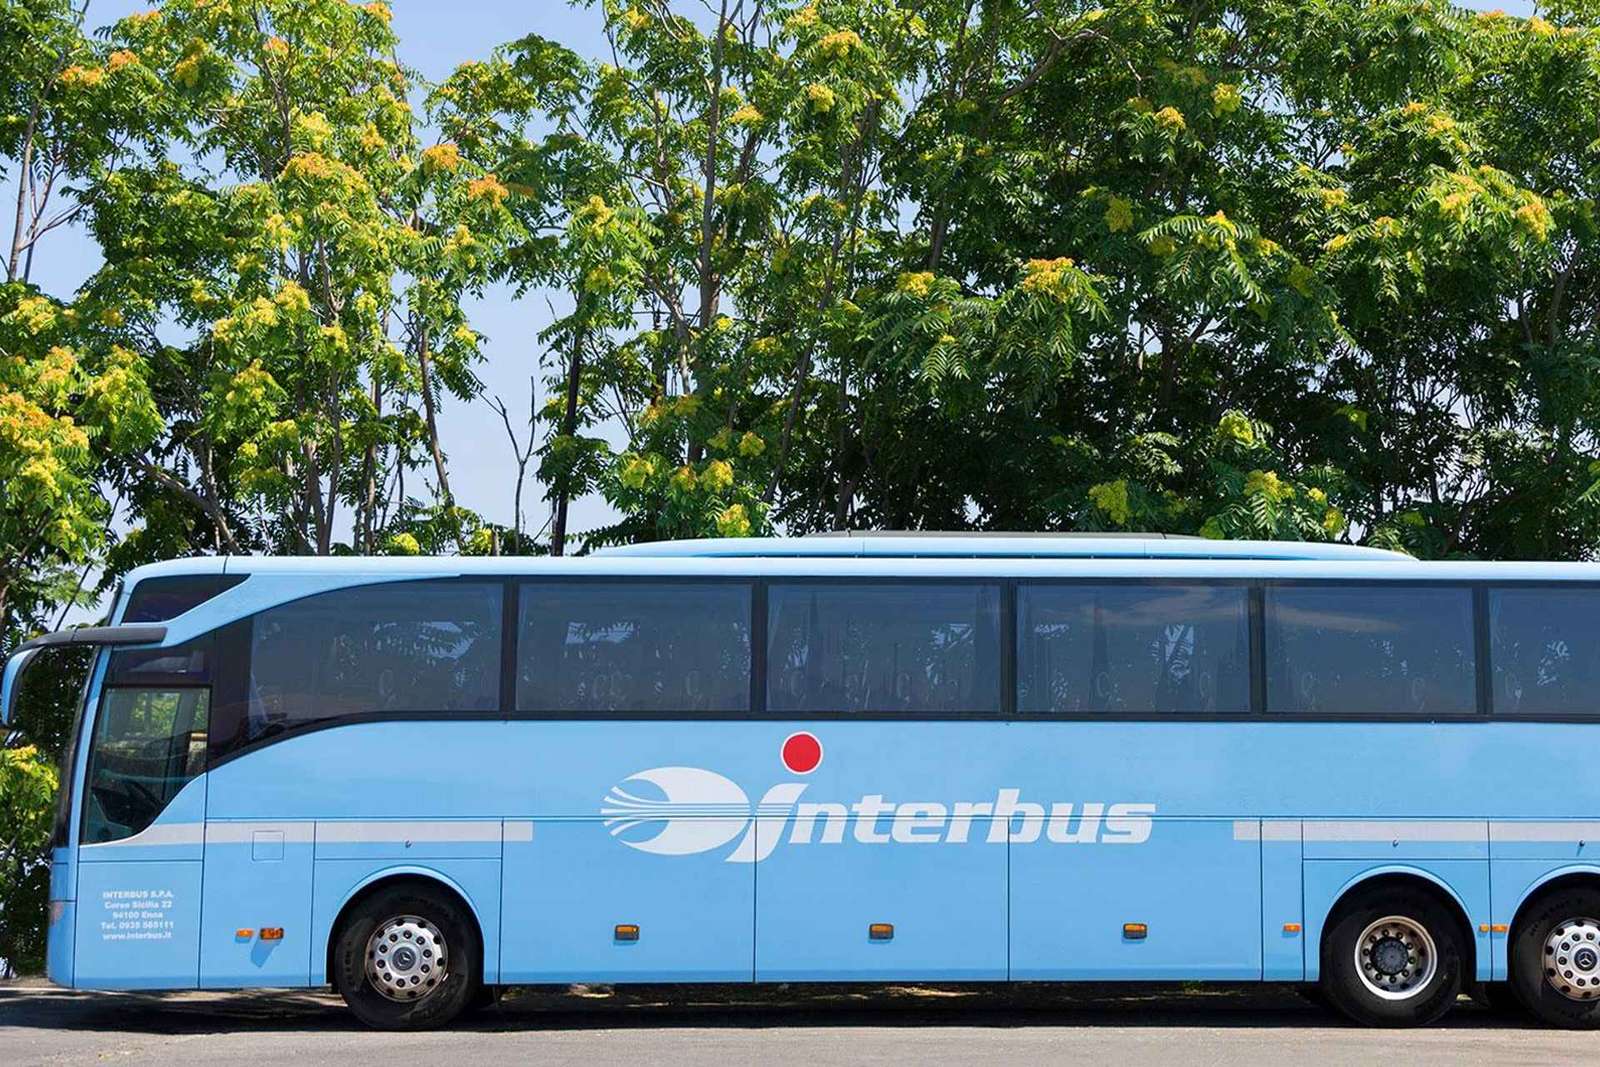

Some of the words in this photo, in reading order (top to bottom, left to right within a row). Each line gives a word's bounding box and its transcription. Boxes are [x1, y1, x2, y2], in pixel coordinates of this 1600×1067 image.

[726, 733, 1156, 863] interbus
[103, 890, 148, 899] INTERBUS
[104, 901, 130, 909] Corso
[132, 901, 159, 909] Sicilia
[141, 911, 163, 919] Enna
[103, 932, 172, 940] www.interbus.it
